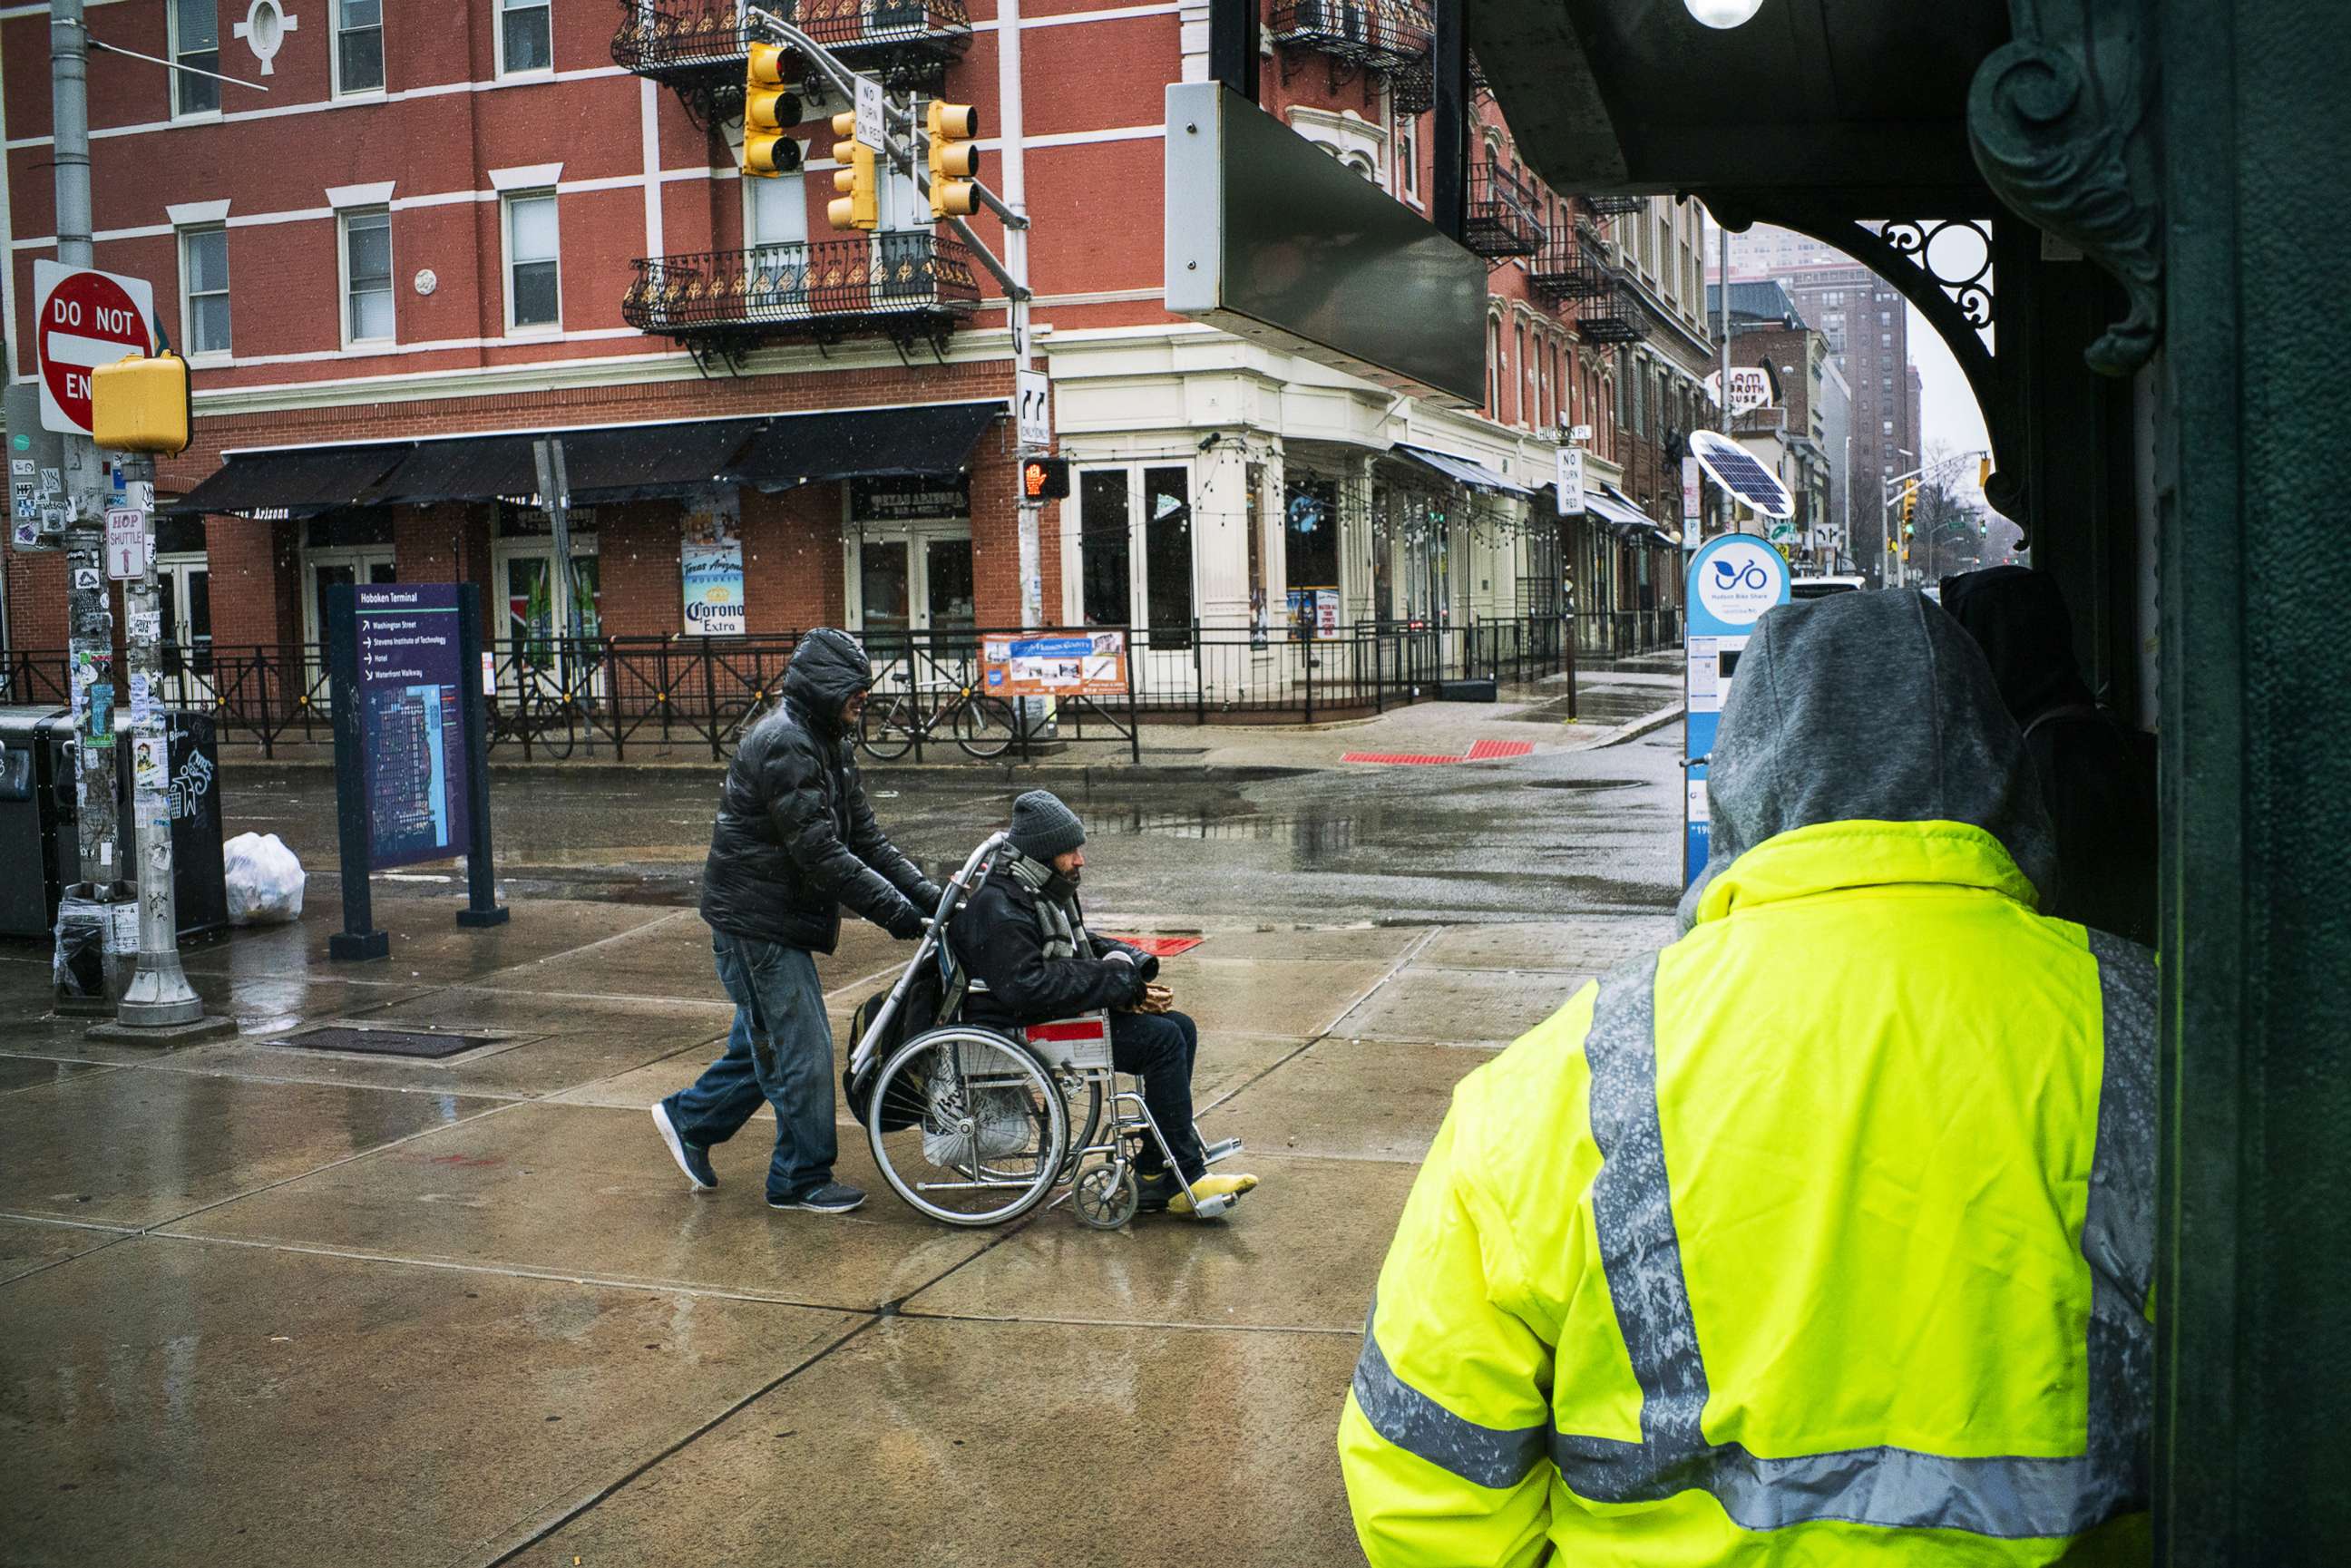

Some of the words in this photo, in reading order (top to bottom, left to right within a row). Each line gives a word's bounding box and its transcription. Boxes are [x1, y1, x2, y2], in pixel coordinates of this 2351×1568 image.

[863, 86, 873, 102] NO
[862, 103, 879, 122] TURN
[870, 126, 882, 142] RED
[54, 297, 81, 326] DO
[96, 306, 133, 336] NOT
[1729, 394, 1757, 404] OUSE
[1563, 453, 1576, 465] NO
[1563, 470, 1578, 480] TURN
[1566, 484, 1575, 493] ON
[1566, 498, 1577, 508] RED
[253, 507, 288, 520] Arizona
[112, 514, 139, 529] HOP
[110, 531, 141, 546] SHUTTLE
[361, 593, 390, 604] Hoboken
[391, 592, 418, 603] Terminal
[373, 621, 401, 631] Washington
[402, 620, 417, 629] Street
[704, 618, 736, 632] Extra
[374, 638, 394, 646] Stevens
[394, 637, 414, 645] Institute
[415, 637, 420, 645] of
[420, 636, 446, 646] Technology
[375, 655, 388, 663] Hotel
[375, 669, 400, 679] Waterfront
[401, 669, 423, 678] Walkway
